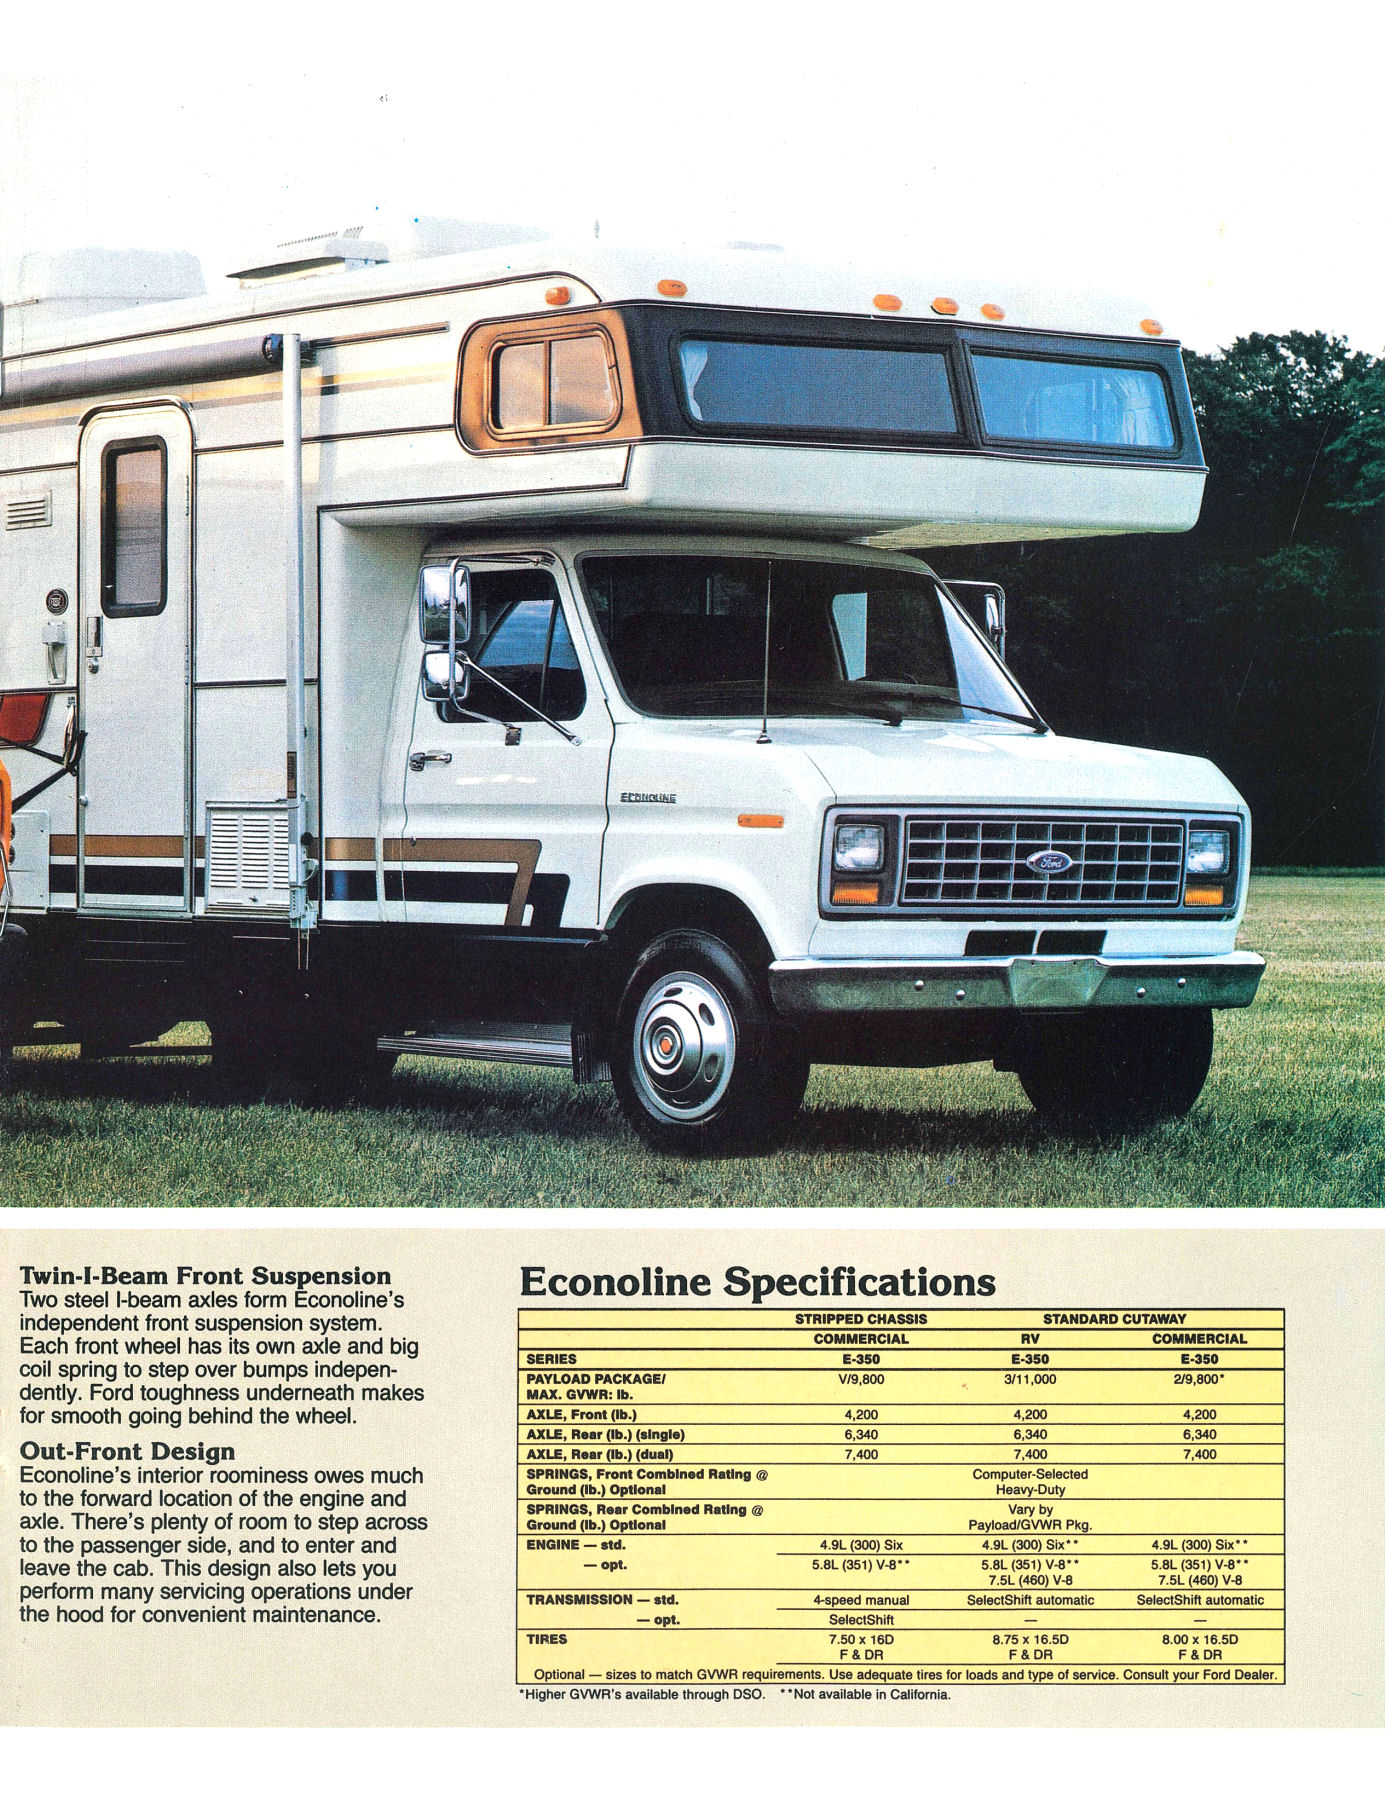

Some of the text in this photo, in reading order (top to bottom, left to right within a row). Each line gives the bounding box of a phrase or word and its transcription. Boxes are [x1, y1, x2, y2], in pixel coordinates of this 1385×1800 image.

[1040, 856, 1064, 868] Ford
[19, 1265, 392, 1290] Twin-I-Beam Front Suspension
[520, 1265, 997, 1305] Econoline Specifications
[18, 1290, 405, 1309] Two steel I-beam axles form Econoline's
[795, 1313, 928, 1325] STRIPPED CHASSIS
[1043, 1313, 1187, 1325] STANDARD CUTAWAY
[813, 1333, 910, 1345] COMMERCIAL
[1021, 1333, 1041, 1345] RV
[1152, 1332, 1248, 1345] COMMERCIAL
[526, 1353, 578, 1365] SERIES
[842, 1353, 881, 1365] E-350
[1011, 1353, 1050, 1365] E-350
[1180, 1353, 1219, 1365] E-350
[526, 1373, 667, 1385] PAYLOAD PACKAGE/
[838, 1373, 885, 1386] V/9,800
[1004, 1373, 1057, 1386] 3/11,000
[526, 1388, 634, 1401] MAX. GVWR: lb.
[526, 1408, 637, 1423] AXLE, Front (lb.)
[844, 1409, 879, 1422] 4,200
[1013, 1408, 1048, 1422] 4,200
[1183, 1408, 1217, 1422] 4,200
[526, 1428, 686, 1443] AXLE, Rear (lb.) (single)
[844, 1428, 879, 1442] 6,340
[1013, 1428, 1048, 1442] 6,340
[1183, 1428, 1217, 1442] 6,340
[19, 1440, 236, 1466] Out-Front Design
[20, 1465, 424, 1484] Econoline's interior roominess owes much
[972, 1468, 1089, 1482] Computer-Selected
[996, 1483, 1066, 1498] Heavy-Duty
[1008, 1503, 1054, 1518] Vary by
[968, 1518, 1093, 1533] Payload/GVWR Pkg.
[813, 1594, 910, 1608] 4-speed manual
[967, 1594, 1095, 1606] SelectShift automatic
[19, 1604, 381, 1624] the hood for convenient maintenance.
[526, 1633, 568, 1645] TIRES
[829, 1633, 895, 1646] 7.50 x 16D
[569, 1688, 622, 1700] GVWR's
[625, 1688, 679, 1700] available
[682, 1688, 730, 1703] through
[733, 1688, 766, 1700] DSO.
[818, 1688, 872, 1700] available
[876, 1691, 887, 1700] in
[890, 1688, 952, 1700] California.
